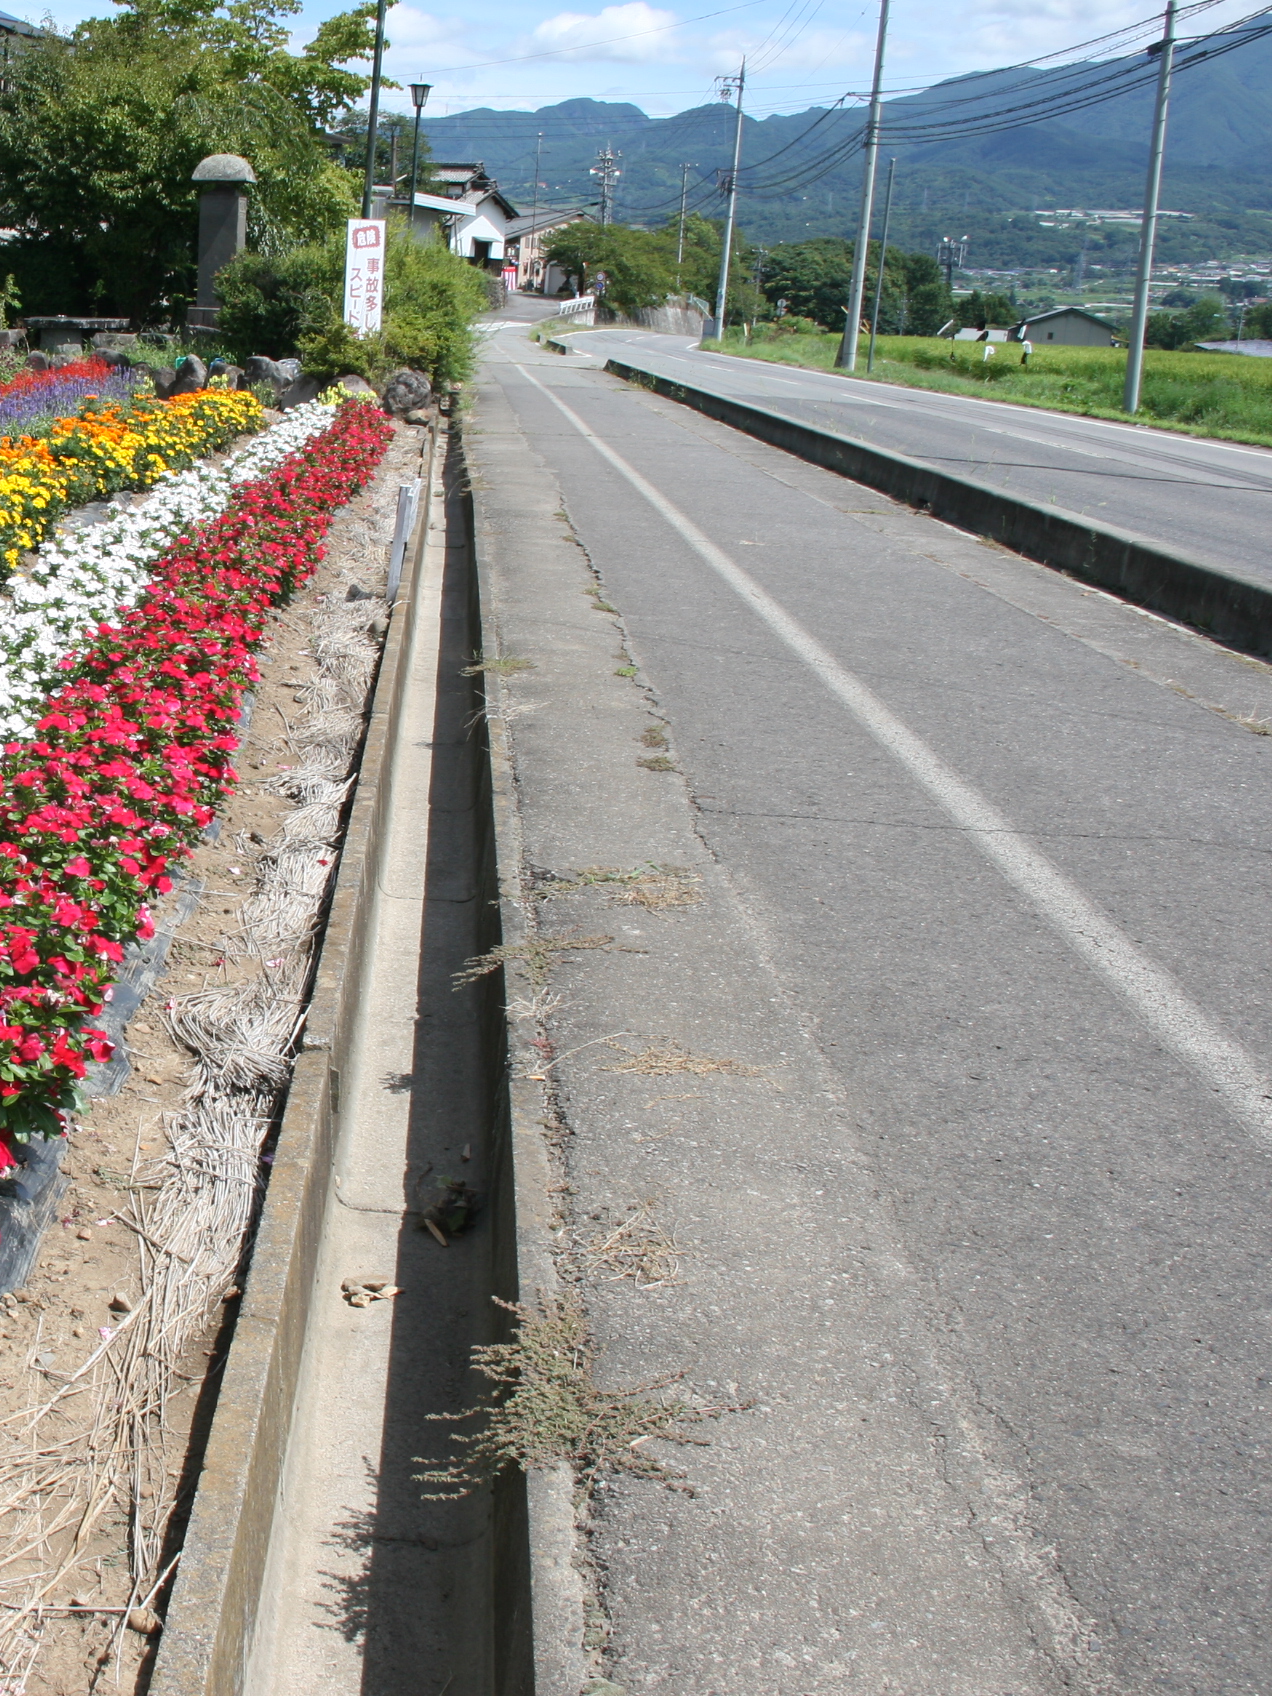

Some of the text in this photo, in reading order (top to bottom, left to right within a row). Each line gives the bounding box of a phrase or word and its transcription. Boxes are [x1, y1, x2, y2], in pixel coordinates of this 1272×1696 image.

[356, 229, 376, 247] 危険
[365, 257, 380, 330] 事故多し
